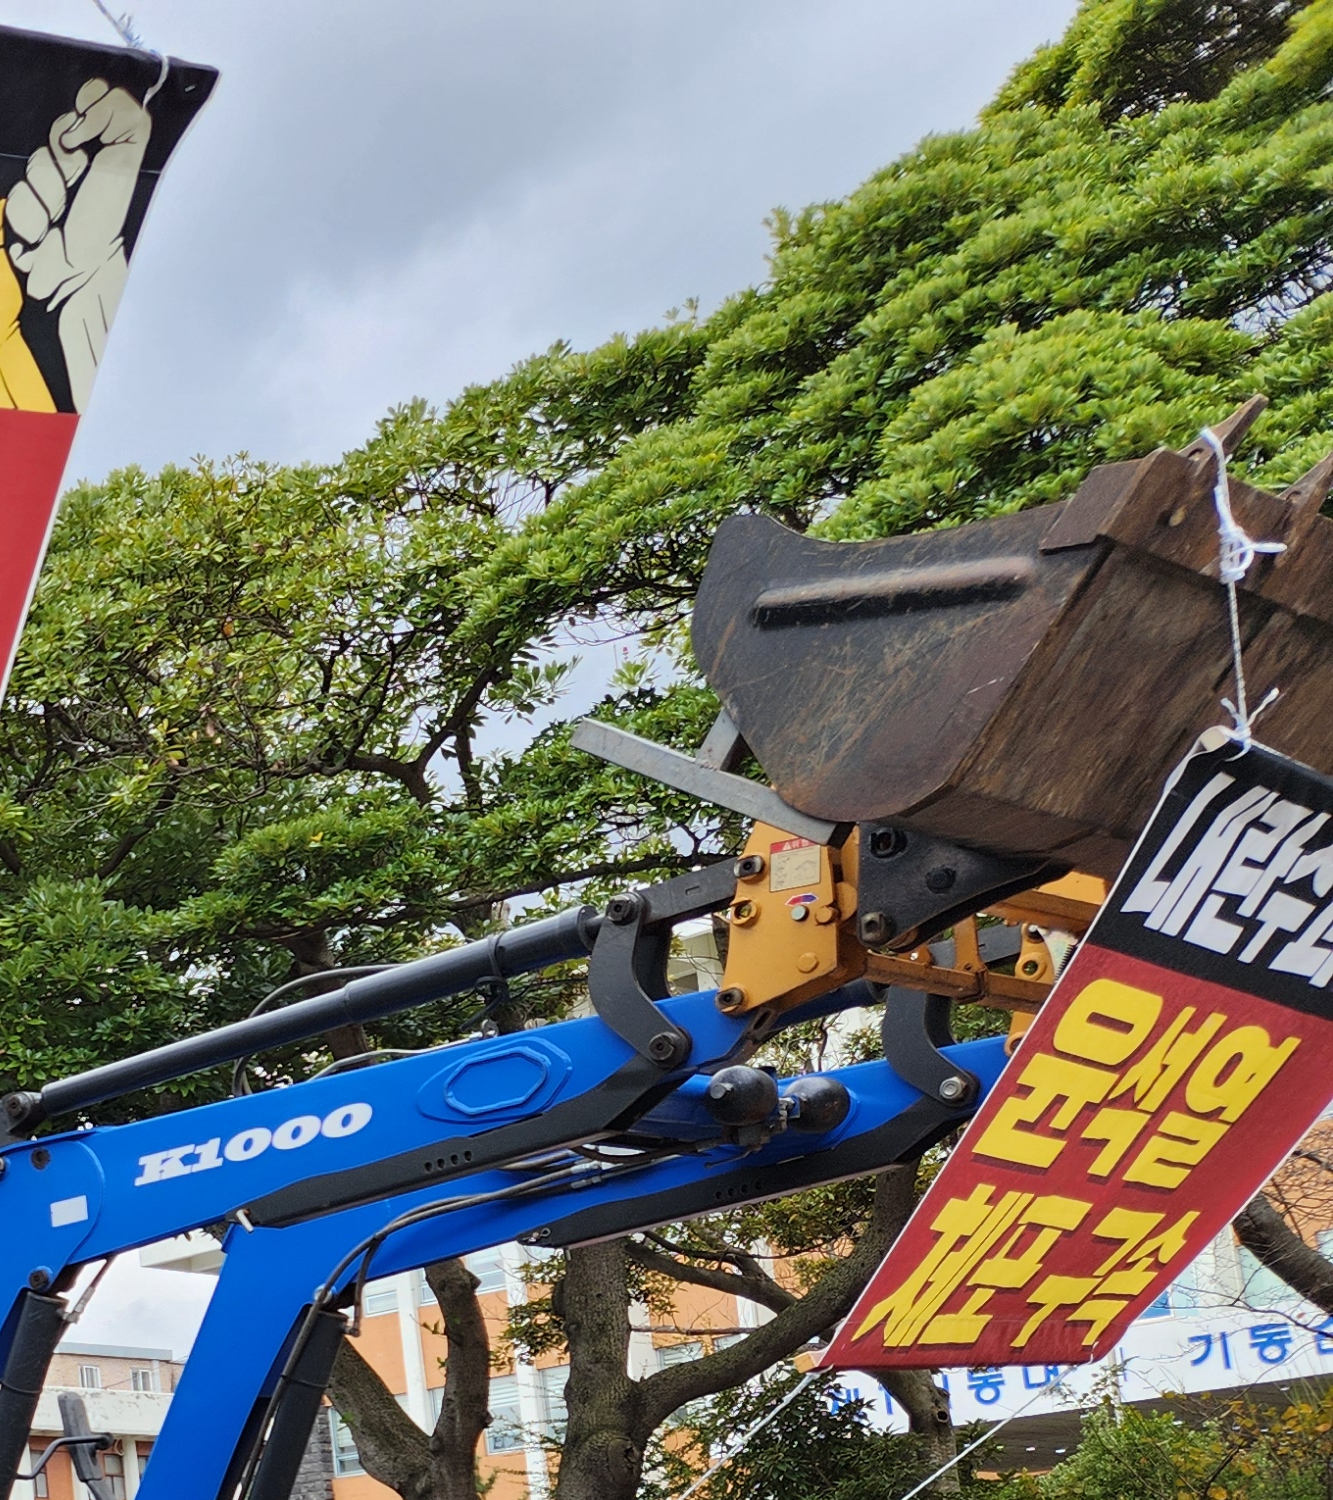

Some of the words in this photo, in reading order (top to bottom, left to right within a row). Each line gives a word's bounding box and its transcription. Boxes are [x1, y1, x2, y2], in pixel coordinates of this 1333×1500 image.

[134, 1102, 373, 1187] K1000
[971, 977, 1301, 1193] 윤석열
[851, 1183, 1093, 1348] 체포
[1010, 1207, 1201, 1348] 구속
